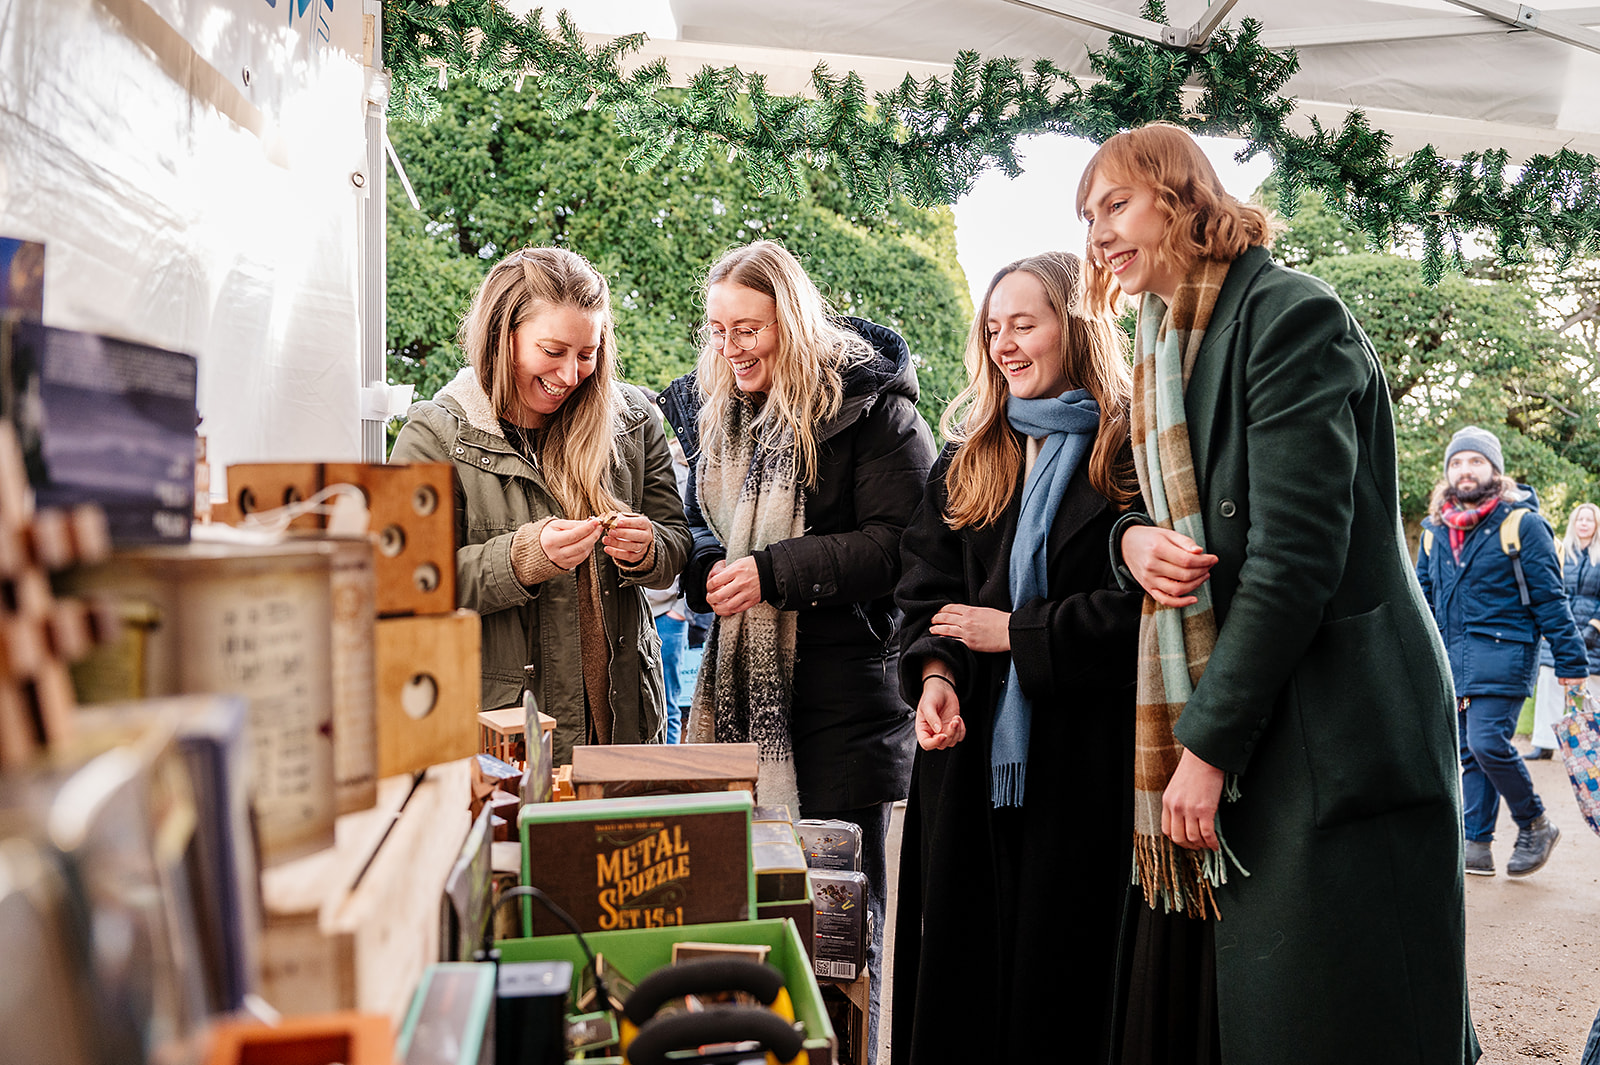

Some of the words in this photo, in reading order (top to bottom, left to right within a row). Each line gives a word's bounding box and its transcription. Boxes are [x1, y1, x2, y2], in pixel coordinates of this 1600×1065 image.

[596, 825, 690, 888] METAL
[617, 854, 690, 906] PUZZLE
[598, 888, 641, 930] SET
